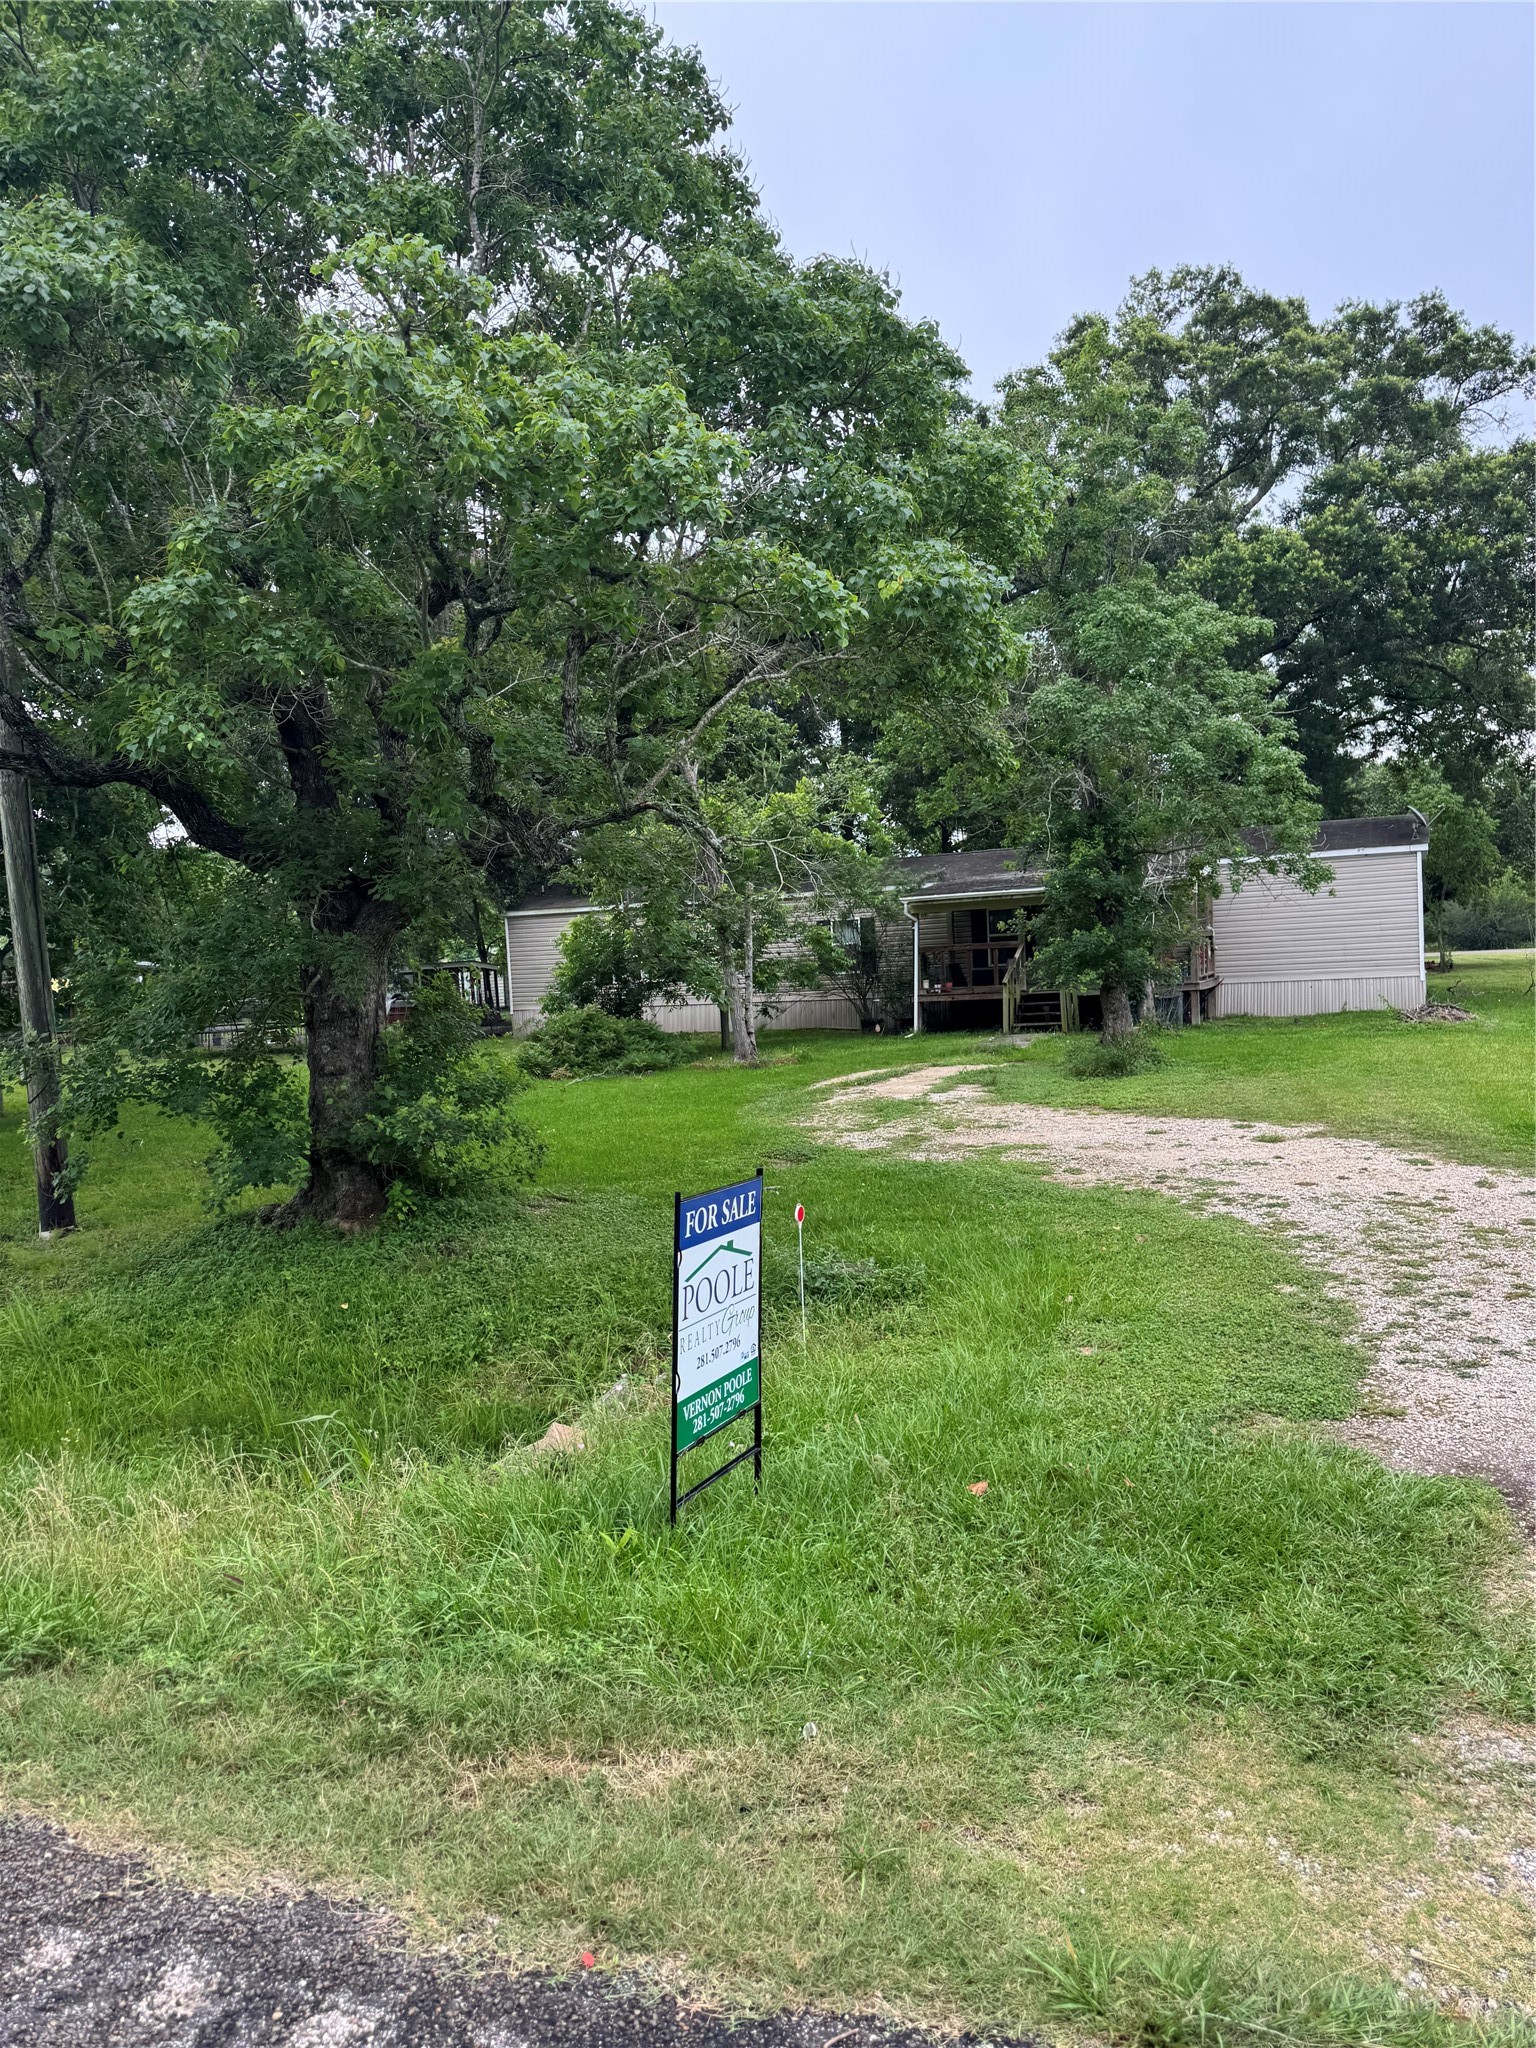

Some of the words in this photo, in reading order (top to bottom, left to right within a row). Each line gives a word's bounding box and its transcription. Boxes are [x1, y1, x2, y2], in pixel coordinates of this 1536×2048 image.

[684, 1203, 718, 1238] FOR
[721, 1190, 756, 1225] SALE
[682, 1257, 755, 1322] POOLE
[679, 1318, 721, 1355] REALTY
[721, 1303, 756, 1335] Group
[696, 1334, 741, 1370] 281.507.2796
[682, 1385, 722, 1421] VERNON
[723, 1367, 753, 1398] POOLE
[692, 1388, 745, 1434] 281-507-2796
